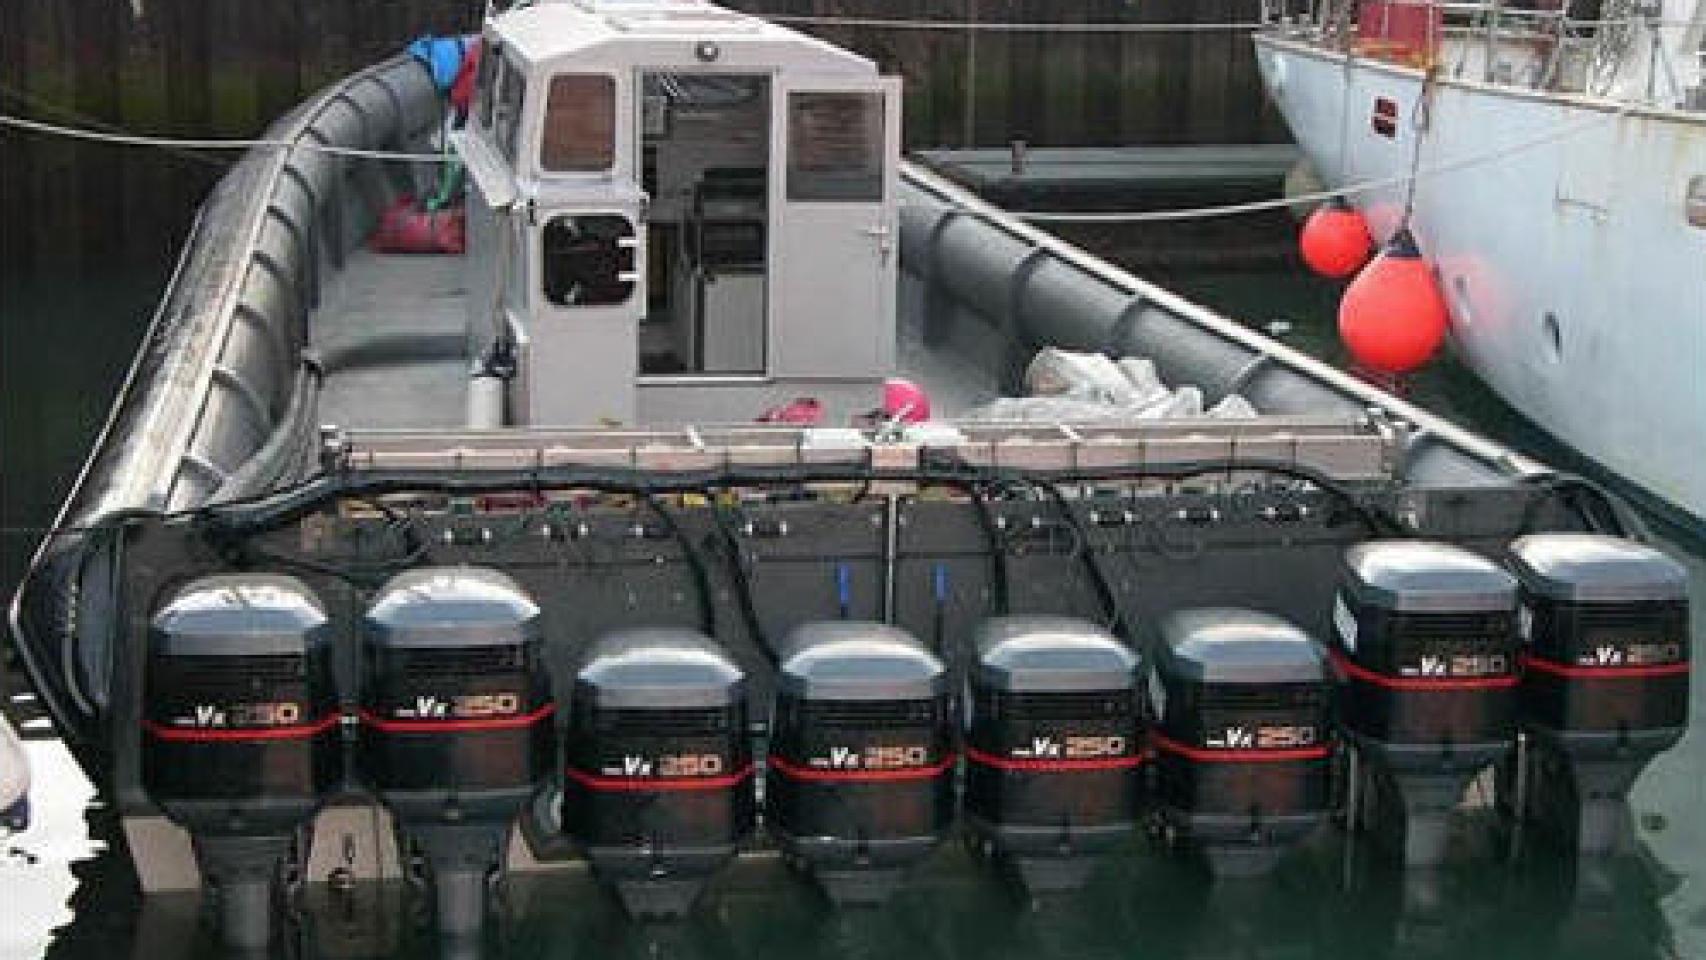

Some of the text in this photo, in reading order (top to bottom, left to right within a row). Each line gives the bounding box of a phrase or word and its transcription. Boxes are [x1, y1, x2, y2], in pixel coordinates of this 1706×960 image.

[452, 694, 517, 717] 250
[1066, 736, 1125, 757] 250
[1257, 726, 1313, 747] 250
[658, 753, 722, 775] 250
[864, 746, 927, 767] 250
